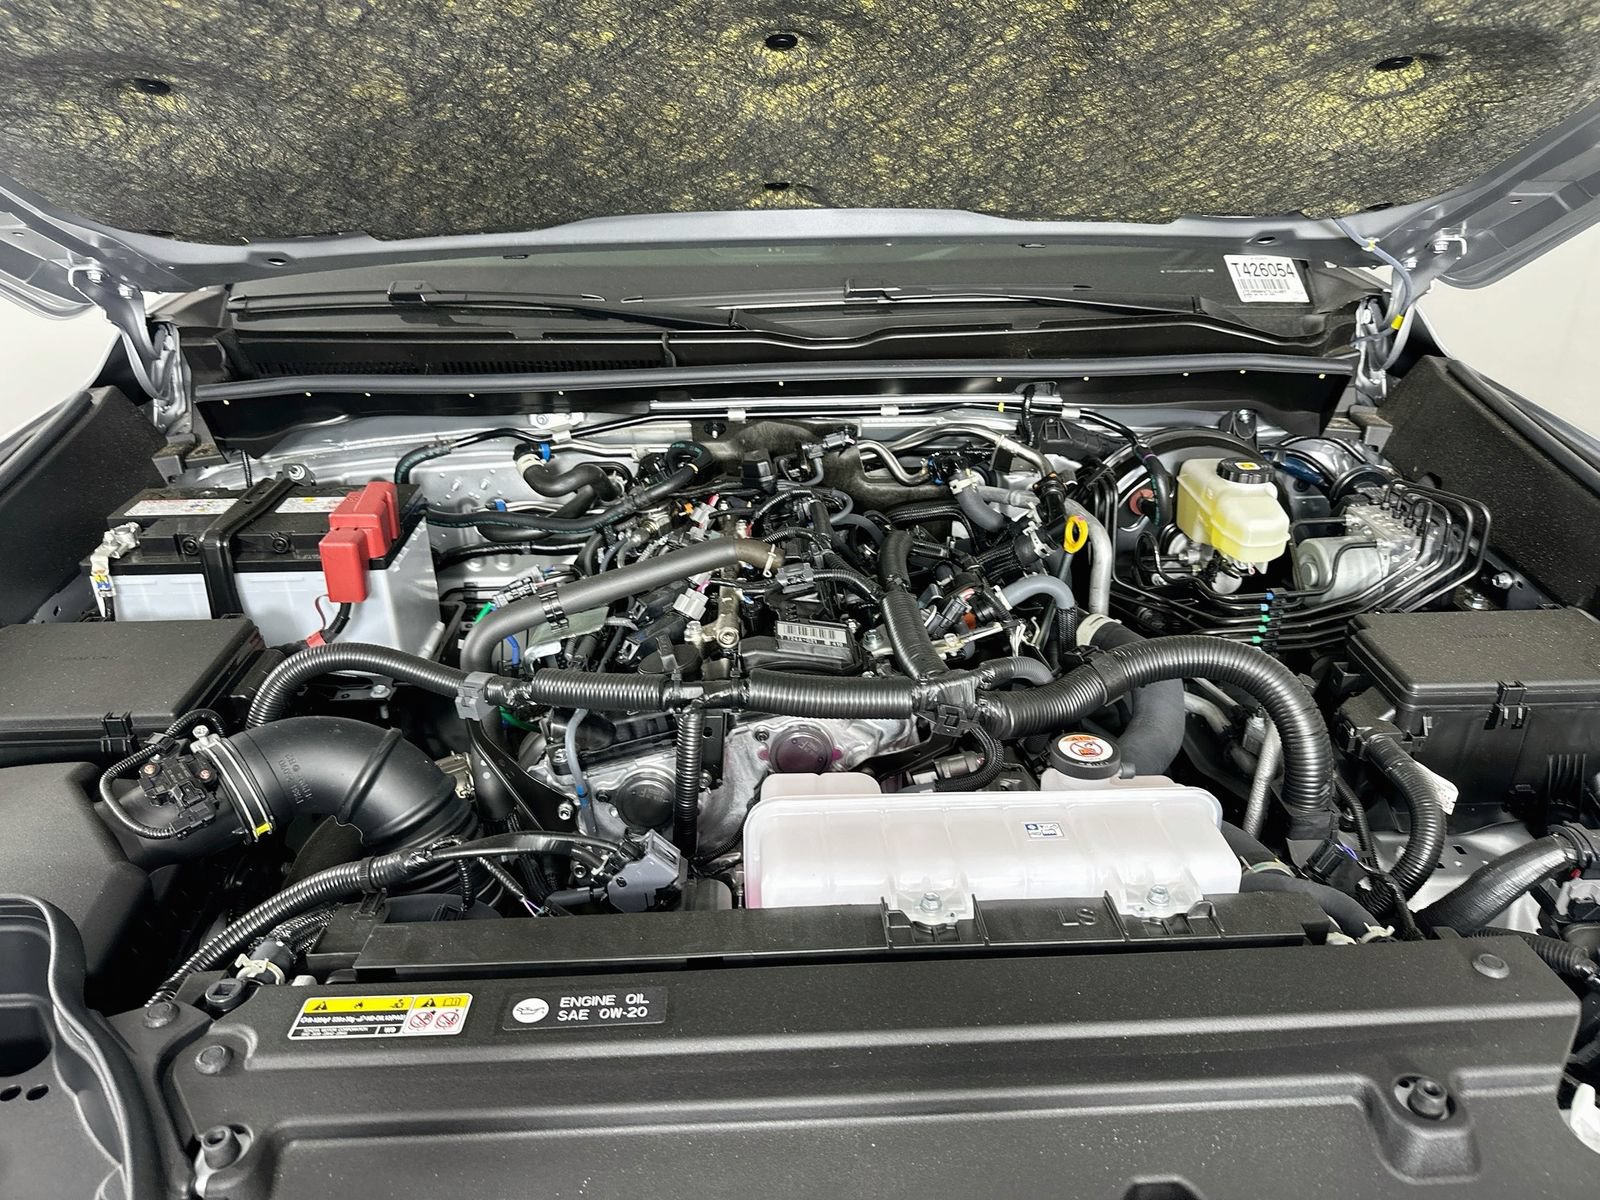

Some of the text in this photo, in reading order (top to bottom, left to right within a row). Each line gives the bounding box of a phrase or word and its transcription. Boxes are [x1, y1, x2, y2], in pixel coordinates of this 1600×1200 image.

[1230, 262, 1295, 278] T426054
[560, 993, 650, 1008] ENGINE OIL
[556, 1005, 648, 1022] SAE 0W-20
